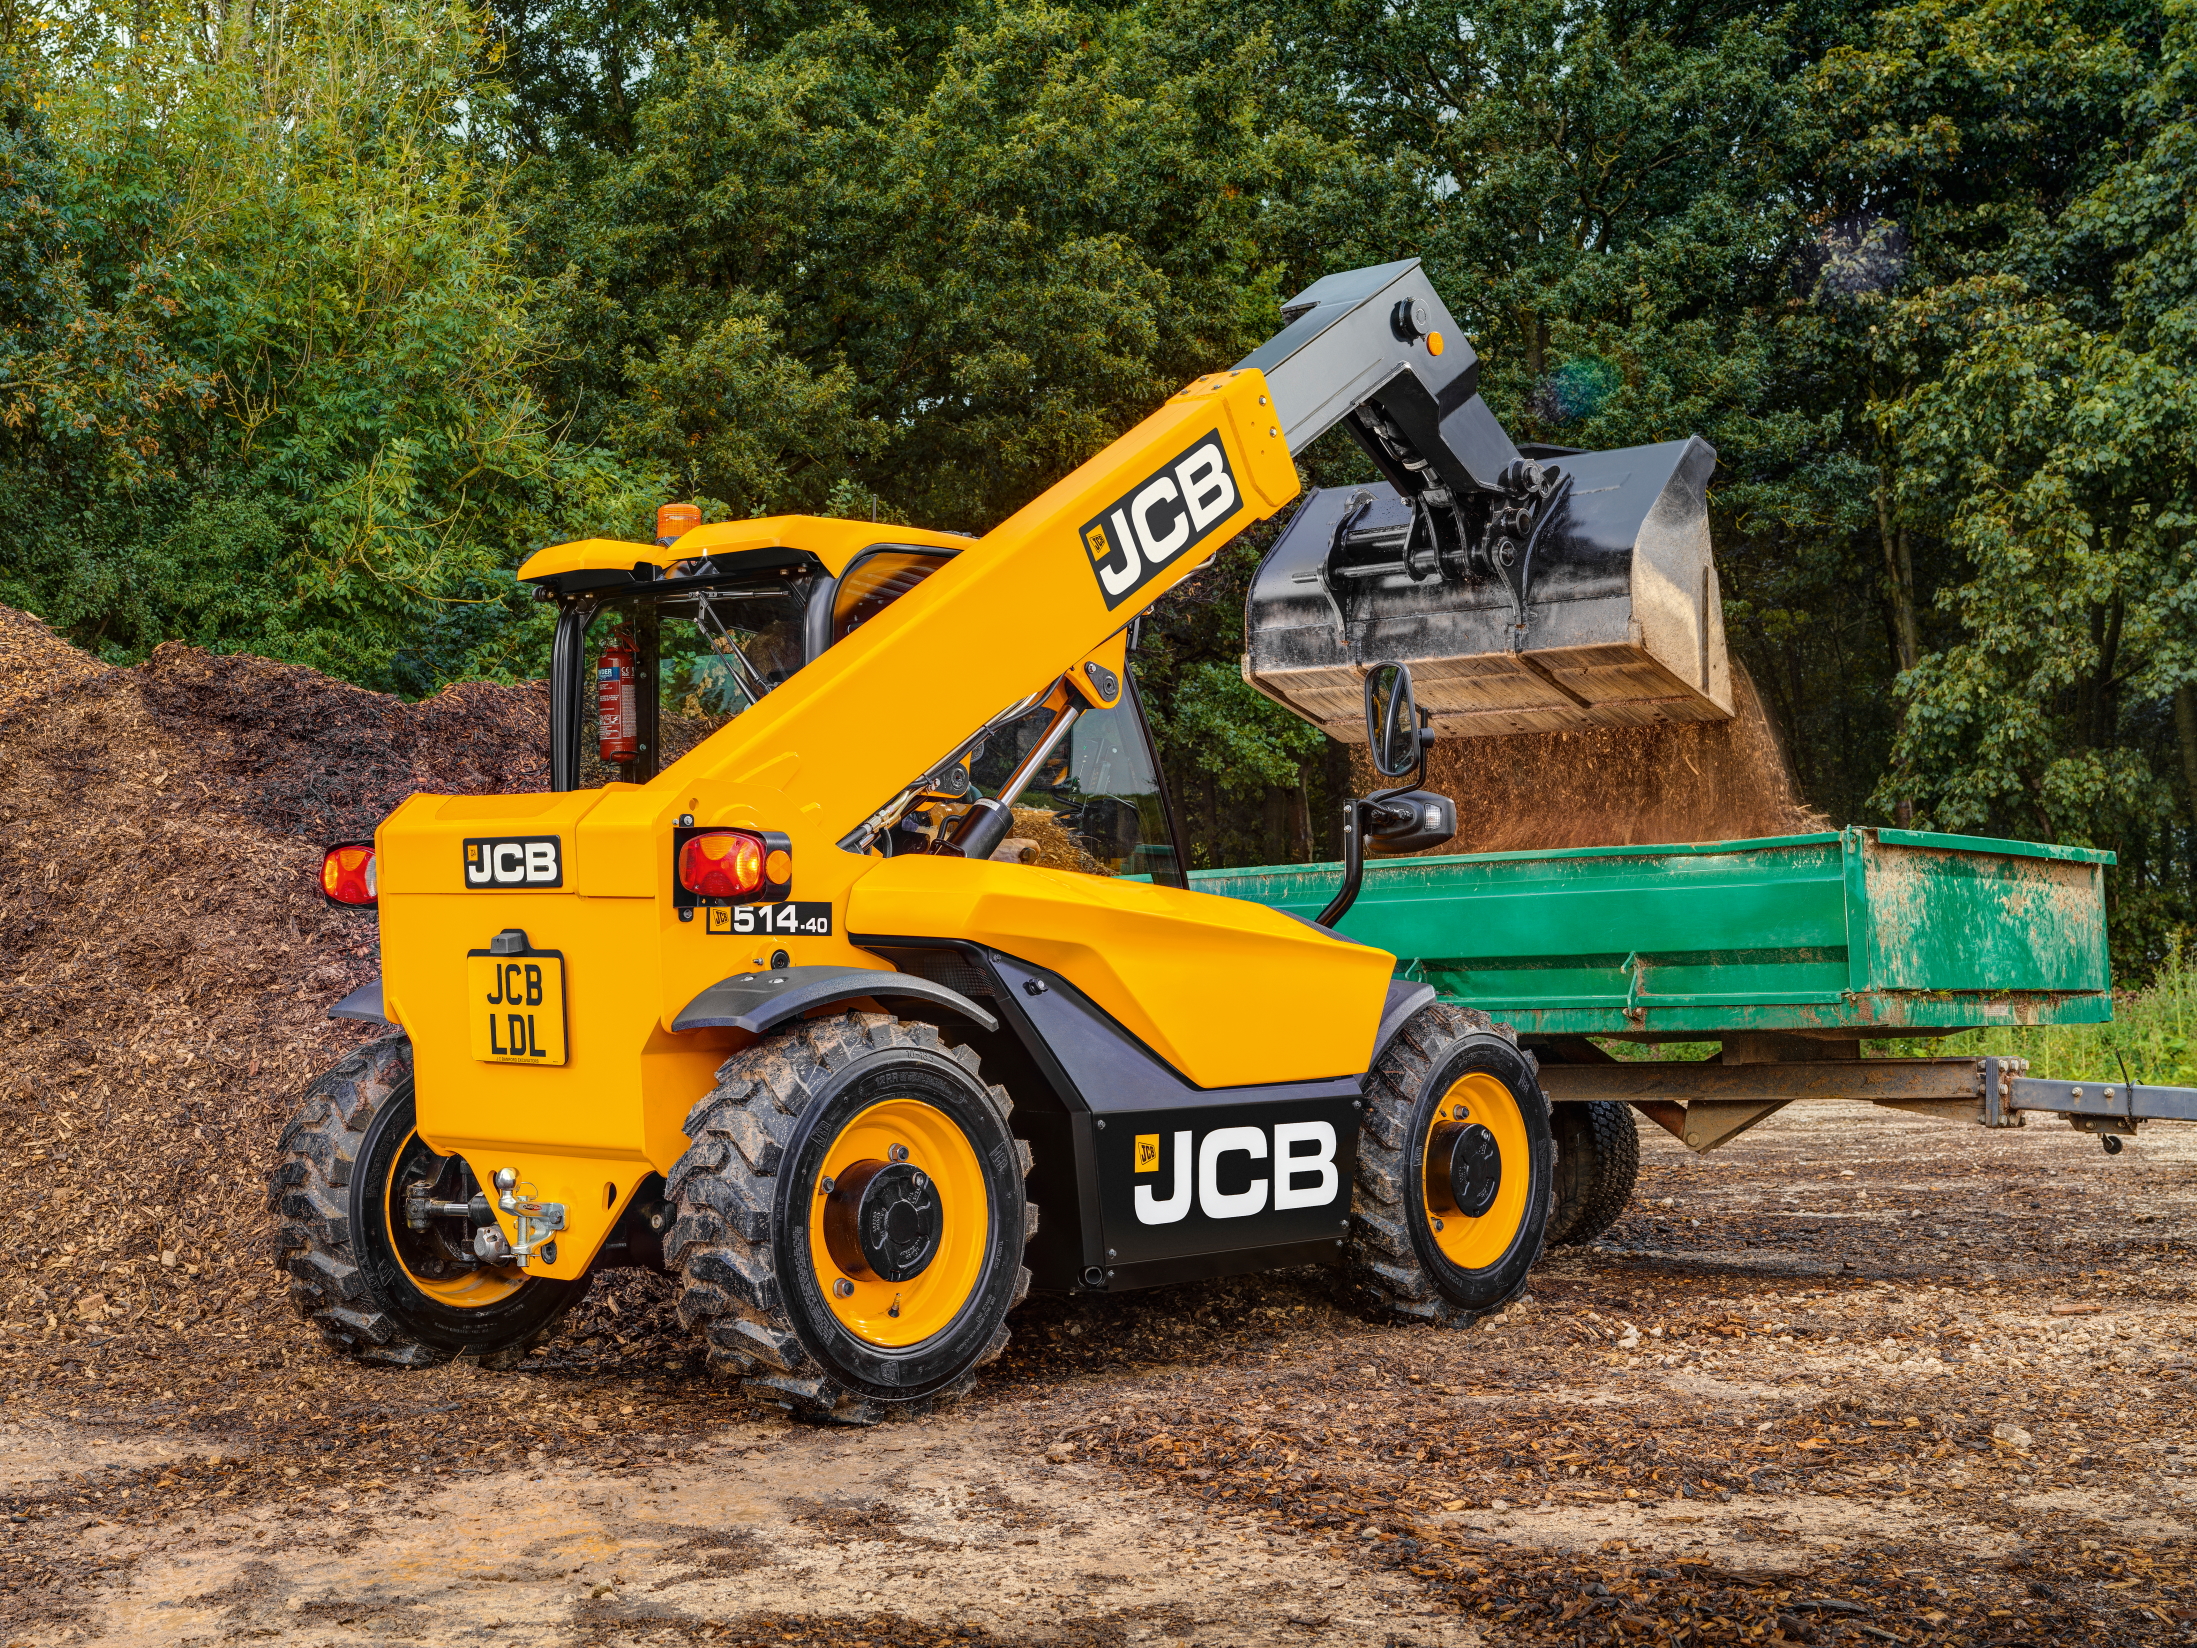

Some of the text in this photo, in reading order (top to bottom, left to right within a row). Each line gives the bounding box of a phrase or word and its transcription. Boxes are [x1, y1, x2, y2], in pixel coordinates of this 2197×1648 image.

[1099, 443, 1235, 595] JCB
[468, 842, 558, 883] JCB
[486, 963, 543, 1006] JCB
[489, 1013, 547, 1057] LDL
[1134, 1120, 1339, 1225] JCB
